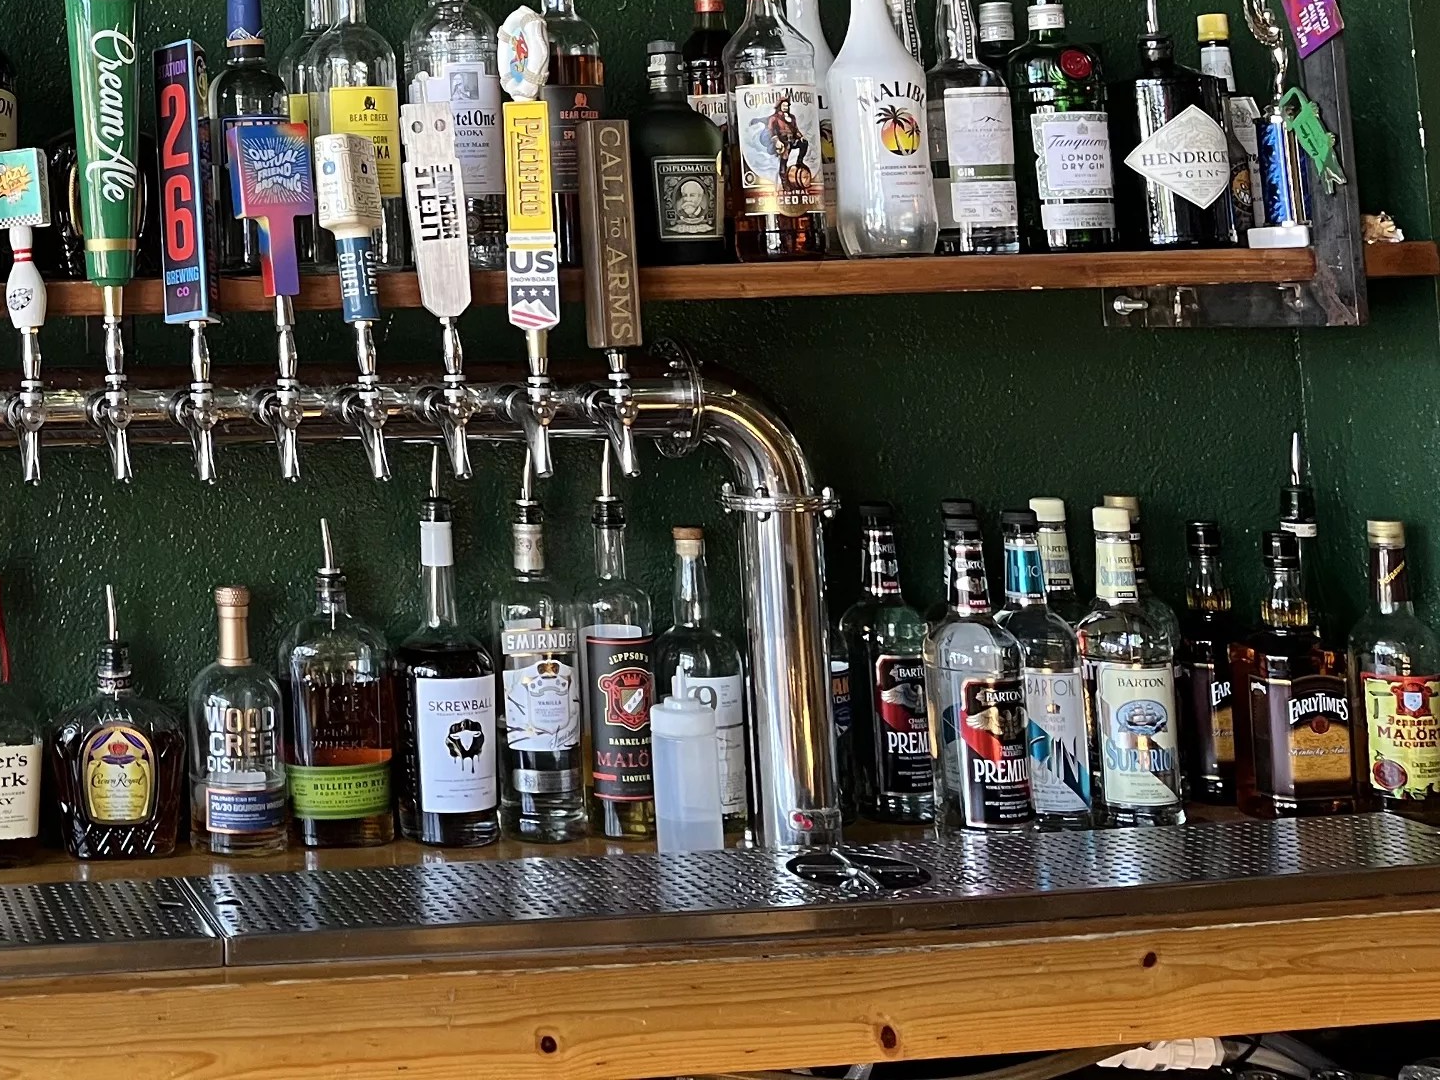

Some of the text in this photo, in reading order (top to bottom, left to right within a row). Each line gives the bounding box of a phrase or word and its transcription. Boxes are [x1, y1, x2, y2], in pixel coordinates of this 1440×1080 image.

[158, 59, 187, 79] STATION
[91, 23, 137, 142] Cream
[743, 88, 782, 110] Captain
[349, 113, 389, 122] BEAR CREEK
[475, 110, 496, 126] One
[560, 110, 599, 119] BEAR CREEK
[1048, 134, 1108, 151] Tanqueray
[248, 146, 276, 162] OUR
[253, 147, 299, 169] MUTUAL
[1061, 154, 1104, 162] LONDON
[85, 140, 138, 203] Ale
[257, 163, 292, 179] FRIEND
[513, 116, 542, 218] PACIFICO
[958, 167, 975, 177] GIN
[1062, 162, 1105, 170] DRY GIN
[1186, 170, 1214, 179] GIN
[255, 172, 302, 195] BREWING
[599, 126, 633, 340] CALL TO ARMS
[509, 250, 556, 273] US
[166, 265, 200, 286] BREWING
[339, 252, 359, 298] CIDER
[176, 286, 190, 298] CO
[506, 632, 577, 651] SMIRNOFF
[1027, 678, 1076, 697] BARTON
[1117, 677, 1165, 689] BARTON
[428, 696, 492, 713] SKREWBALL
[985, 691, 1023, 703] BARTON
[1288, 691, 1350, 725] EARLY TIMES
[609, 737, 640, 746] BARREL
[1393, 740, 1437, 749] LIQUEUR
[91, 773, 147, 789] Crown Royal
[313, 783, 353, 791] BULLEIT
